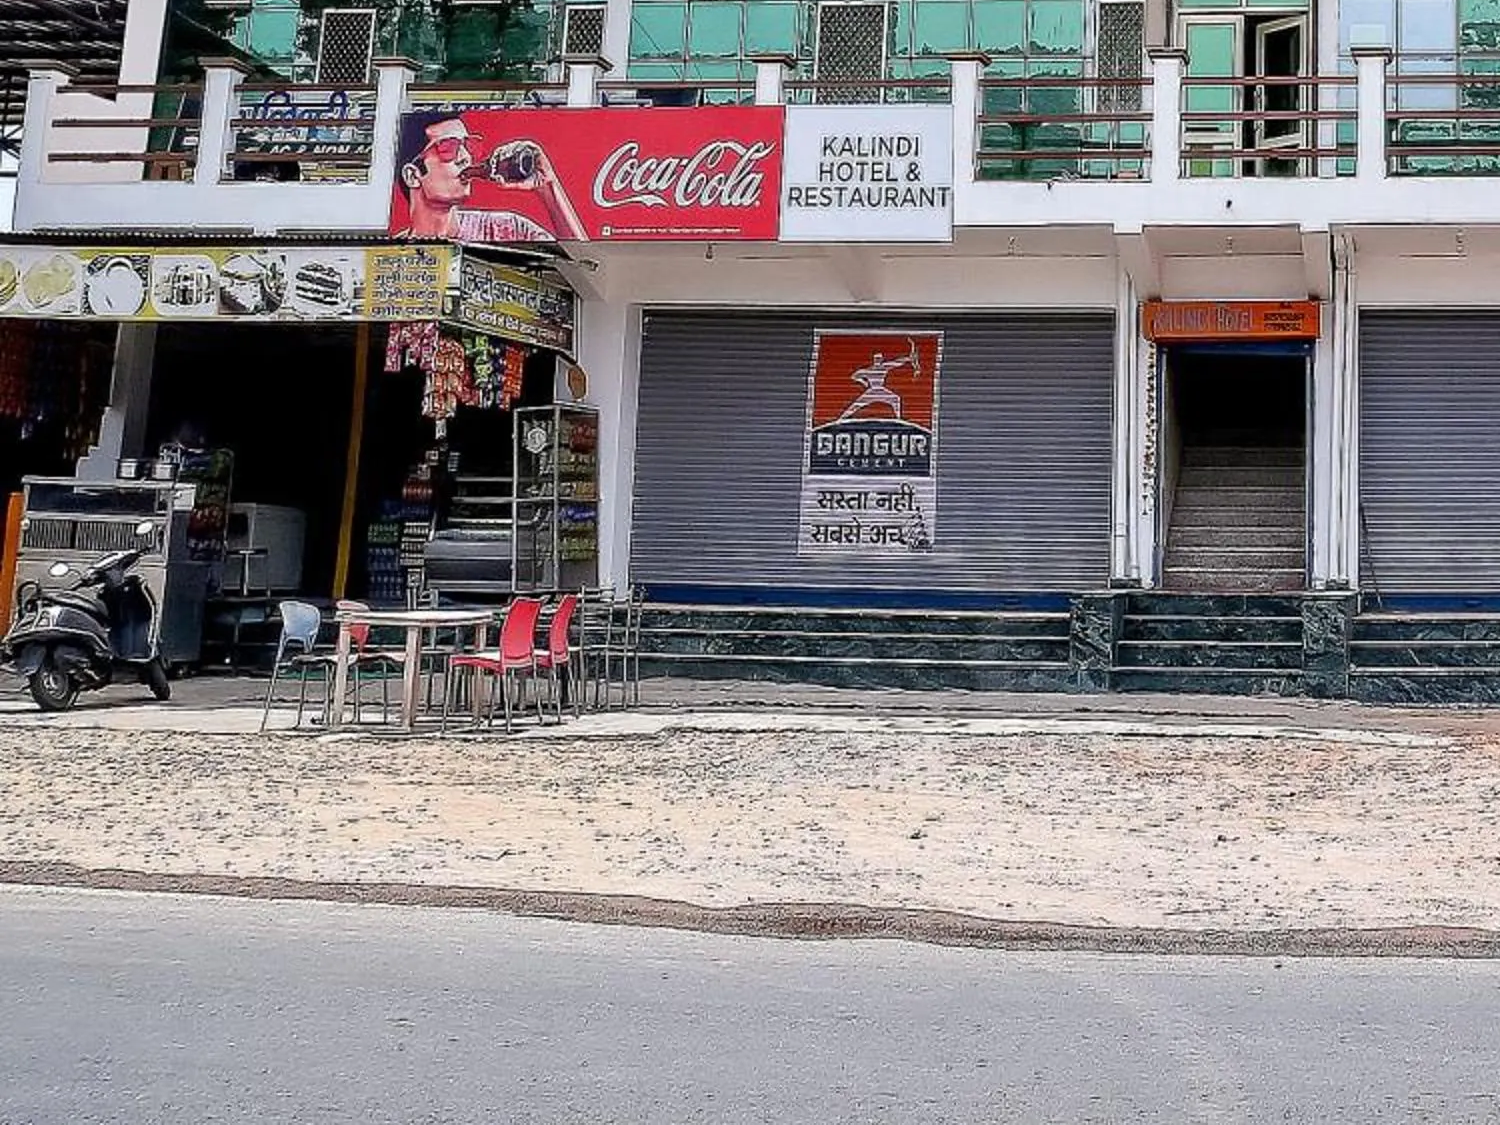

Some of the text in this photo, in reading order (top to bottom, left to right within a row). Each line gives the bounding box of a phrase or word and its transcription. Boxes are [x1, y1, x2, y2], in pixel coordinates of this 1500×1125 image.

[822, 135, 920, 157] KALINDI
[593, 138, 776, 210] Coca-Cola
[817, 162, 922, 183] HOTEL &
[788, 186, 951, 208] RESTAURANT
[816, 432, 928, 456] BANGUR
[816, 490, 869, 511] सस्ता
[810, 516, 862, 544] सबसे
